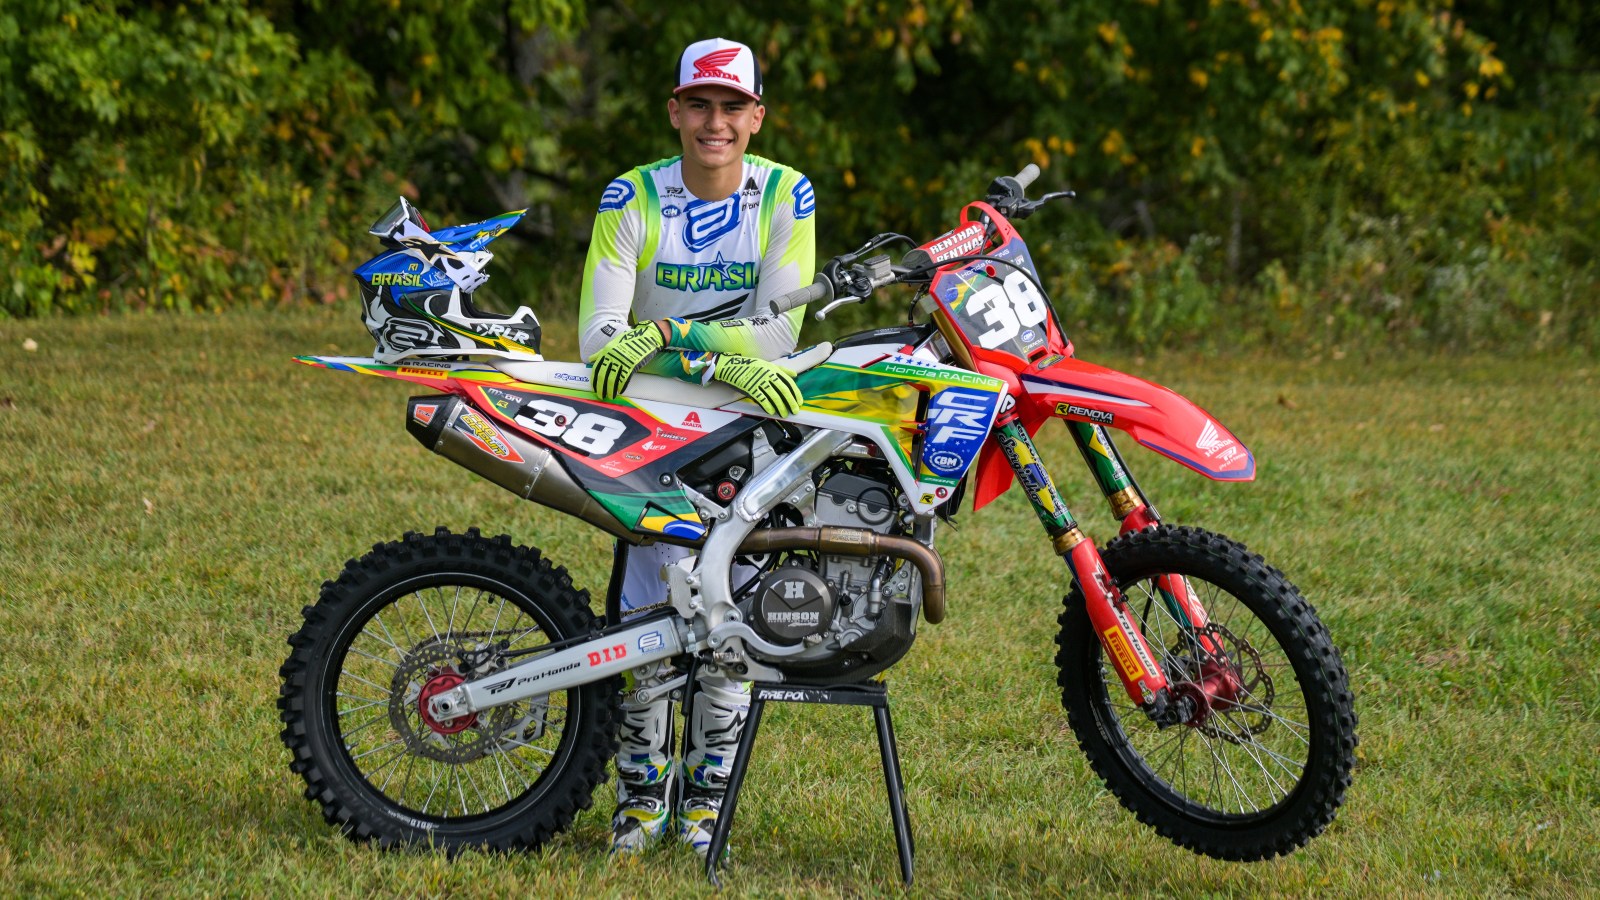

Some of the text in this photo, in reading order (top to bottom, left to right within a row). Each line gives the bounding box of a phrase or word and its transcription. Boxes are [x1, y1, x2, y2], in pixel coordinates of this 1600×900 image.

[692, 70, 741, 83] HONDA
[930, 225, 981, 255] RENTHAL
[408, 263, 419, 272] R1
[371, 273, 424, 287] BRASIL
[965, 267, 1048, 349] 38
[619, 326, 648, 343] ASW
[412, 361, 452, 369] RACING
[725, 356, 757, 366] ASW
[401, 367, 444, 377] PIRELLI
[885, 364, 999, 387] Honda RACING
[928, 391, 990, 444] CRF
[1068, 405, 1114, 420] RENOVA
[470, 414, 497, 436] PRO
[513, 399, 627, 455] 38
[461, 415, 507, 456] CIRCUIT
[1205, 438, 1234, 457] HONDA
[934, 455, 958, 467] CBM
[783, 581, 805, 599] H
[767, 611, 820, 621] HINSON
[1109, 630, 1139, 676] PIRELLI
[1127, 630, 1158, 677] Honda
[517, 661, 581, 686] Pro Honda
